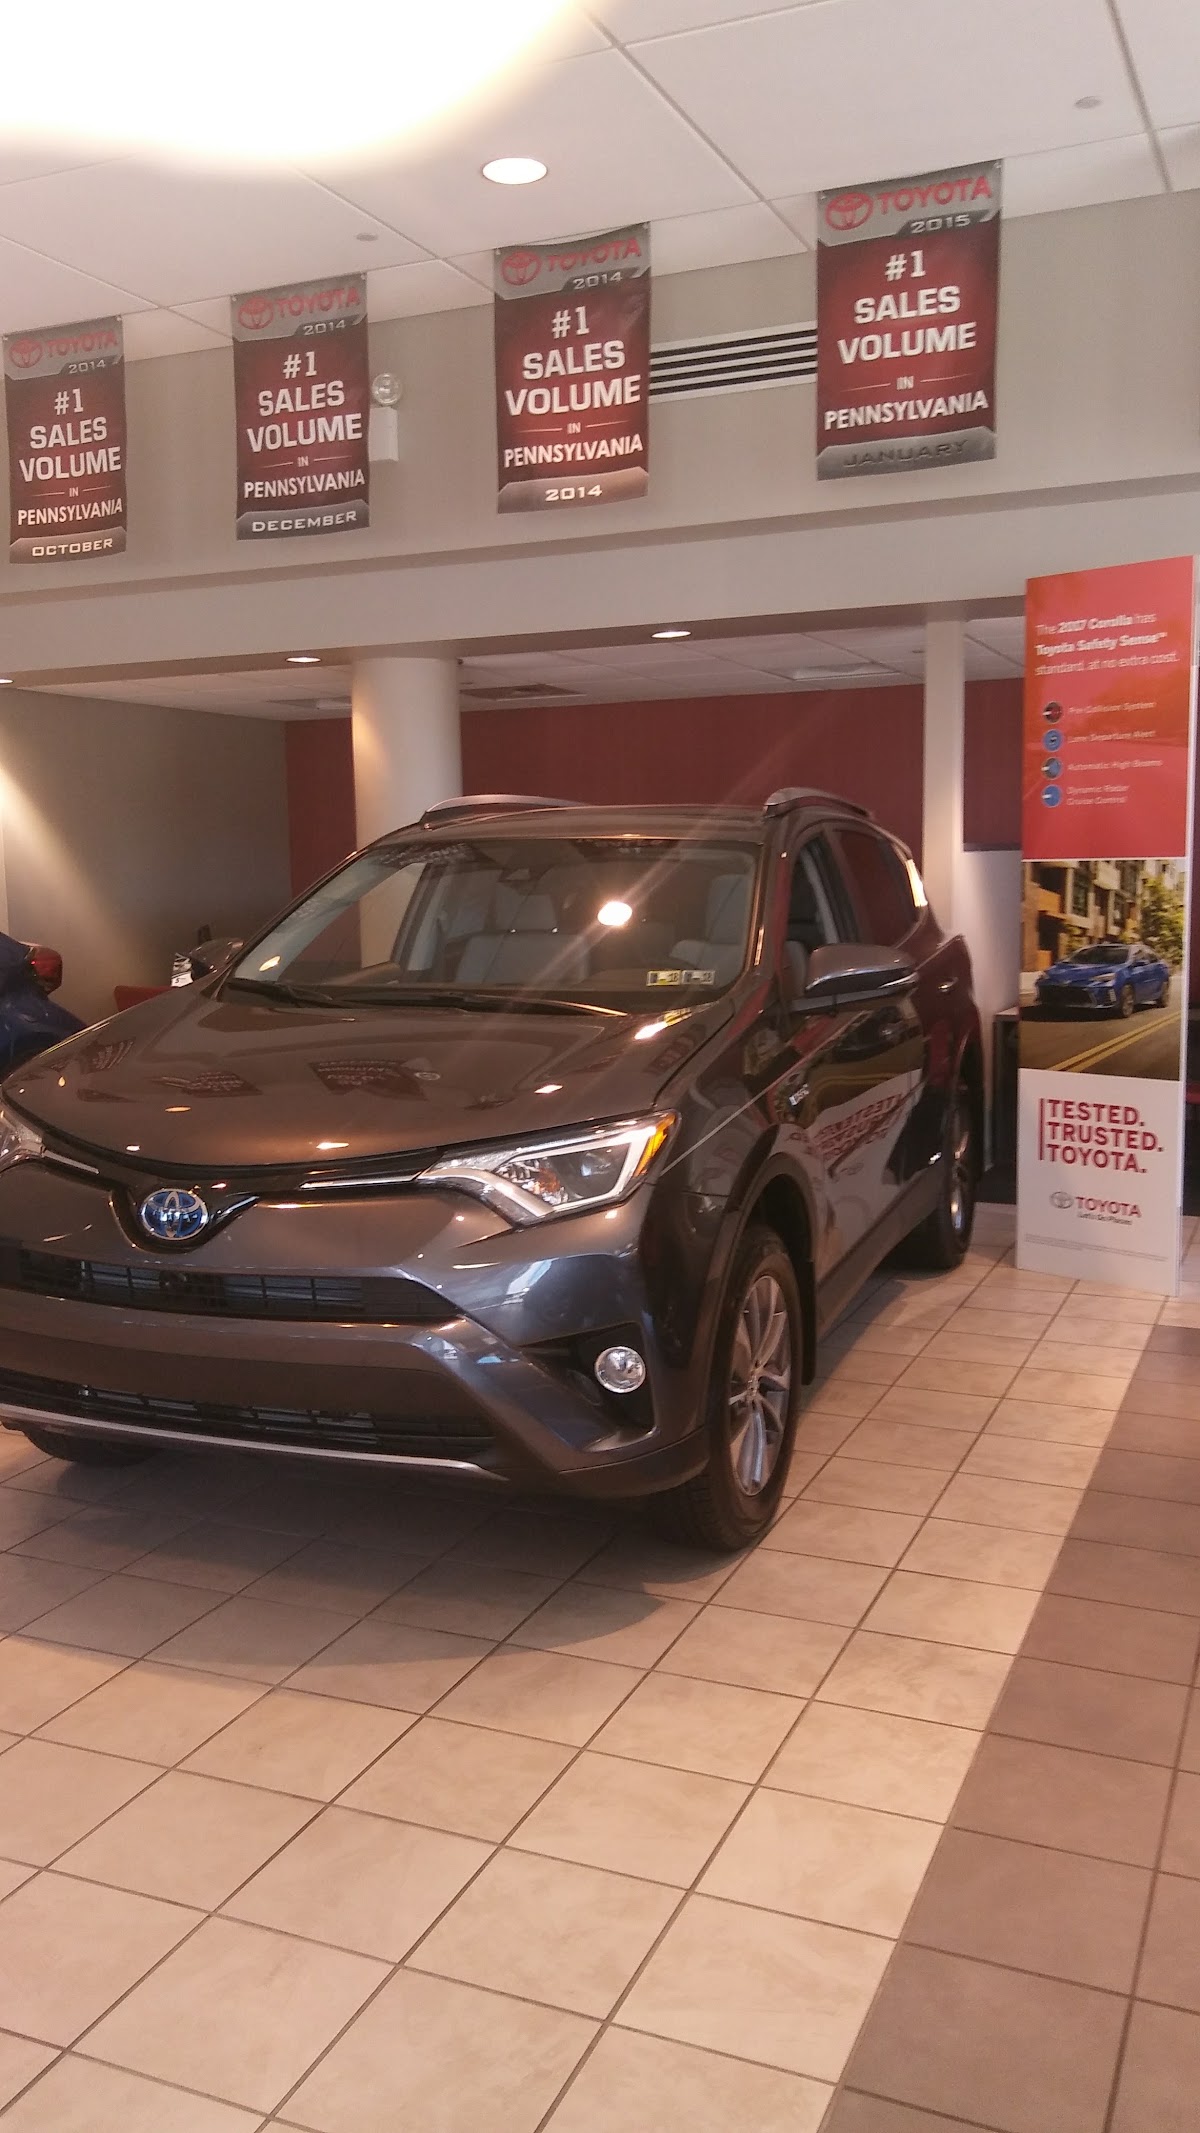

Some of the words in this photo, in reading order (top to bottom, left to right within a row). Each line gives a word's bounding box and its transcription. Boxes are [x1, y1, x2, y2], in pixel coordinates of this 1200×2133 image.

[876, 175, 993, 215] TOYOTA
[910, 213, 971, 234] 2015
[546, 236, 642, 272] TOYOTA
[884, 249, 926, 282] #1
[573, 271, 623, 290] 2014
[276, 286, 361, 319] TOYOTA
[853, 285, 961, 325] SALES
[303, 319, 347, 336] 2014
[552, 305, 590, 339] #1
[45, 329, 119, 358] TOYOTA
[837, 321, 977, 365] VOLUME
[68, 359, 107, 374] 2014
[283, 351, 318, 380] #1
[522, 339, 626, 380] SALES
[505, 374, 642, 417] VOLUME
[896, 375, 914, 390] IN
[54, 388, 84, 416] #1
[258, 380, 345, 417] SALES
[824, 389, 989, 431] PENNSYLVANIA
[29, 416, 107, 449] SALES
[247, 413, 363, 453] VOLUME
[567, 422, 581, 434] IN
[19, 446, 122, 482] VOLUME
[297, 456, 309, 467] IN
[503, 433, 644, 468] PENNSYLVANIA
[842, 439, 969, 468] JANUARY
[69, 487, 79, 498] IN
[244, 468, 365, 499] PENNSYLVANIA
[545, 485, 603, 502] 2014
[17, 497, 123, 526] PENNSYLVANIA
[251, 511, 357, 533] DECEMBER
[31, 538, 113, 557] OCTOBER
[1035, 624, 1055, 635] The
[1087, 614, 1133, 630] Corolla
[1135, 613, 1157, 624] has
[1035, 642, 1076, 657] Toyota
[1076, 637, 1118, 652] Safety
[1103, 658, 1117, 668] no
[1119, 655, 1149, 668] extra
[1067, 762, 1110, 771] Automatic
[1048, 1098, 1146, 1127] TESTED.
[1047, 1121, 1164, 1153] TRUSTED.
[1047, 1143, 1148, 1174] TOYOTA.
[1075, 1196, 1142, 1218] TOYOTA
